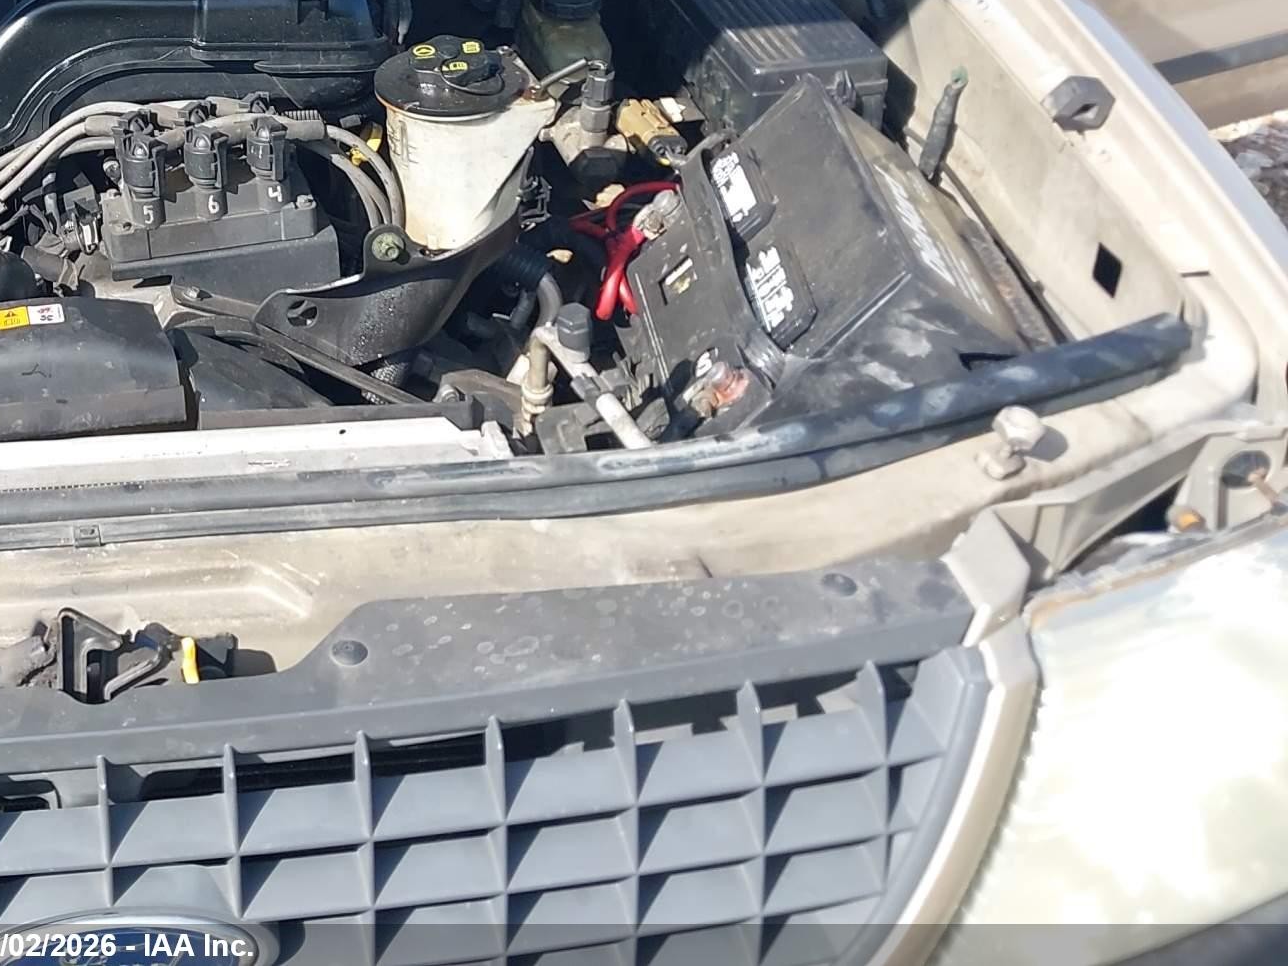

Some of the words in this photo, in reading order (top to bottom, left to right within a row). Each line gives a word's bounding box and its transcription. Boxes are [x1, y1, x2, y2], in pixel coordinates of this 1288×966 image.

[207, 194, 220, 214] 6
[268, 186, 282, 202] 4
[143, 204, 154, 224] 5
